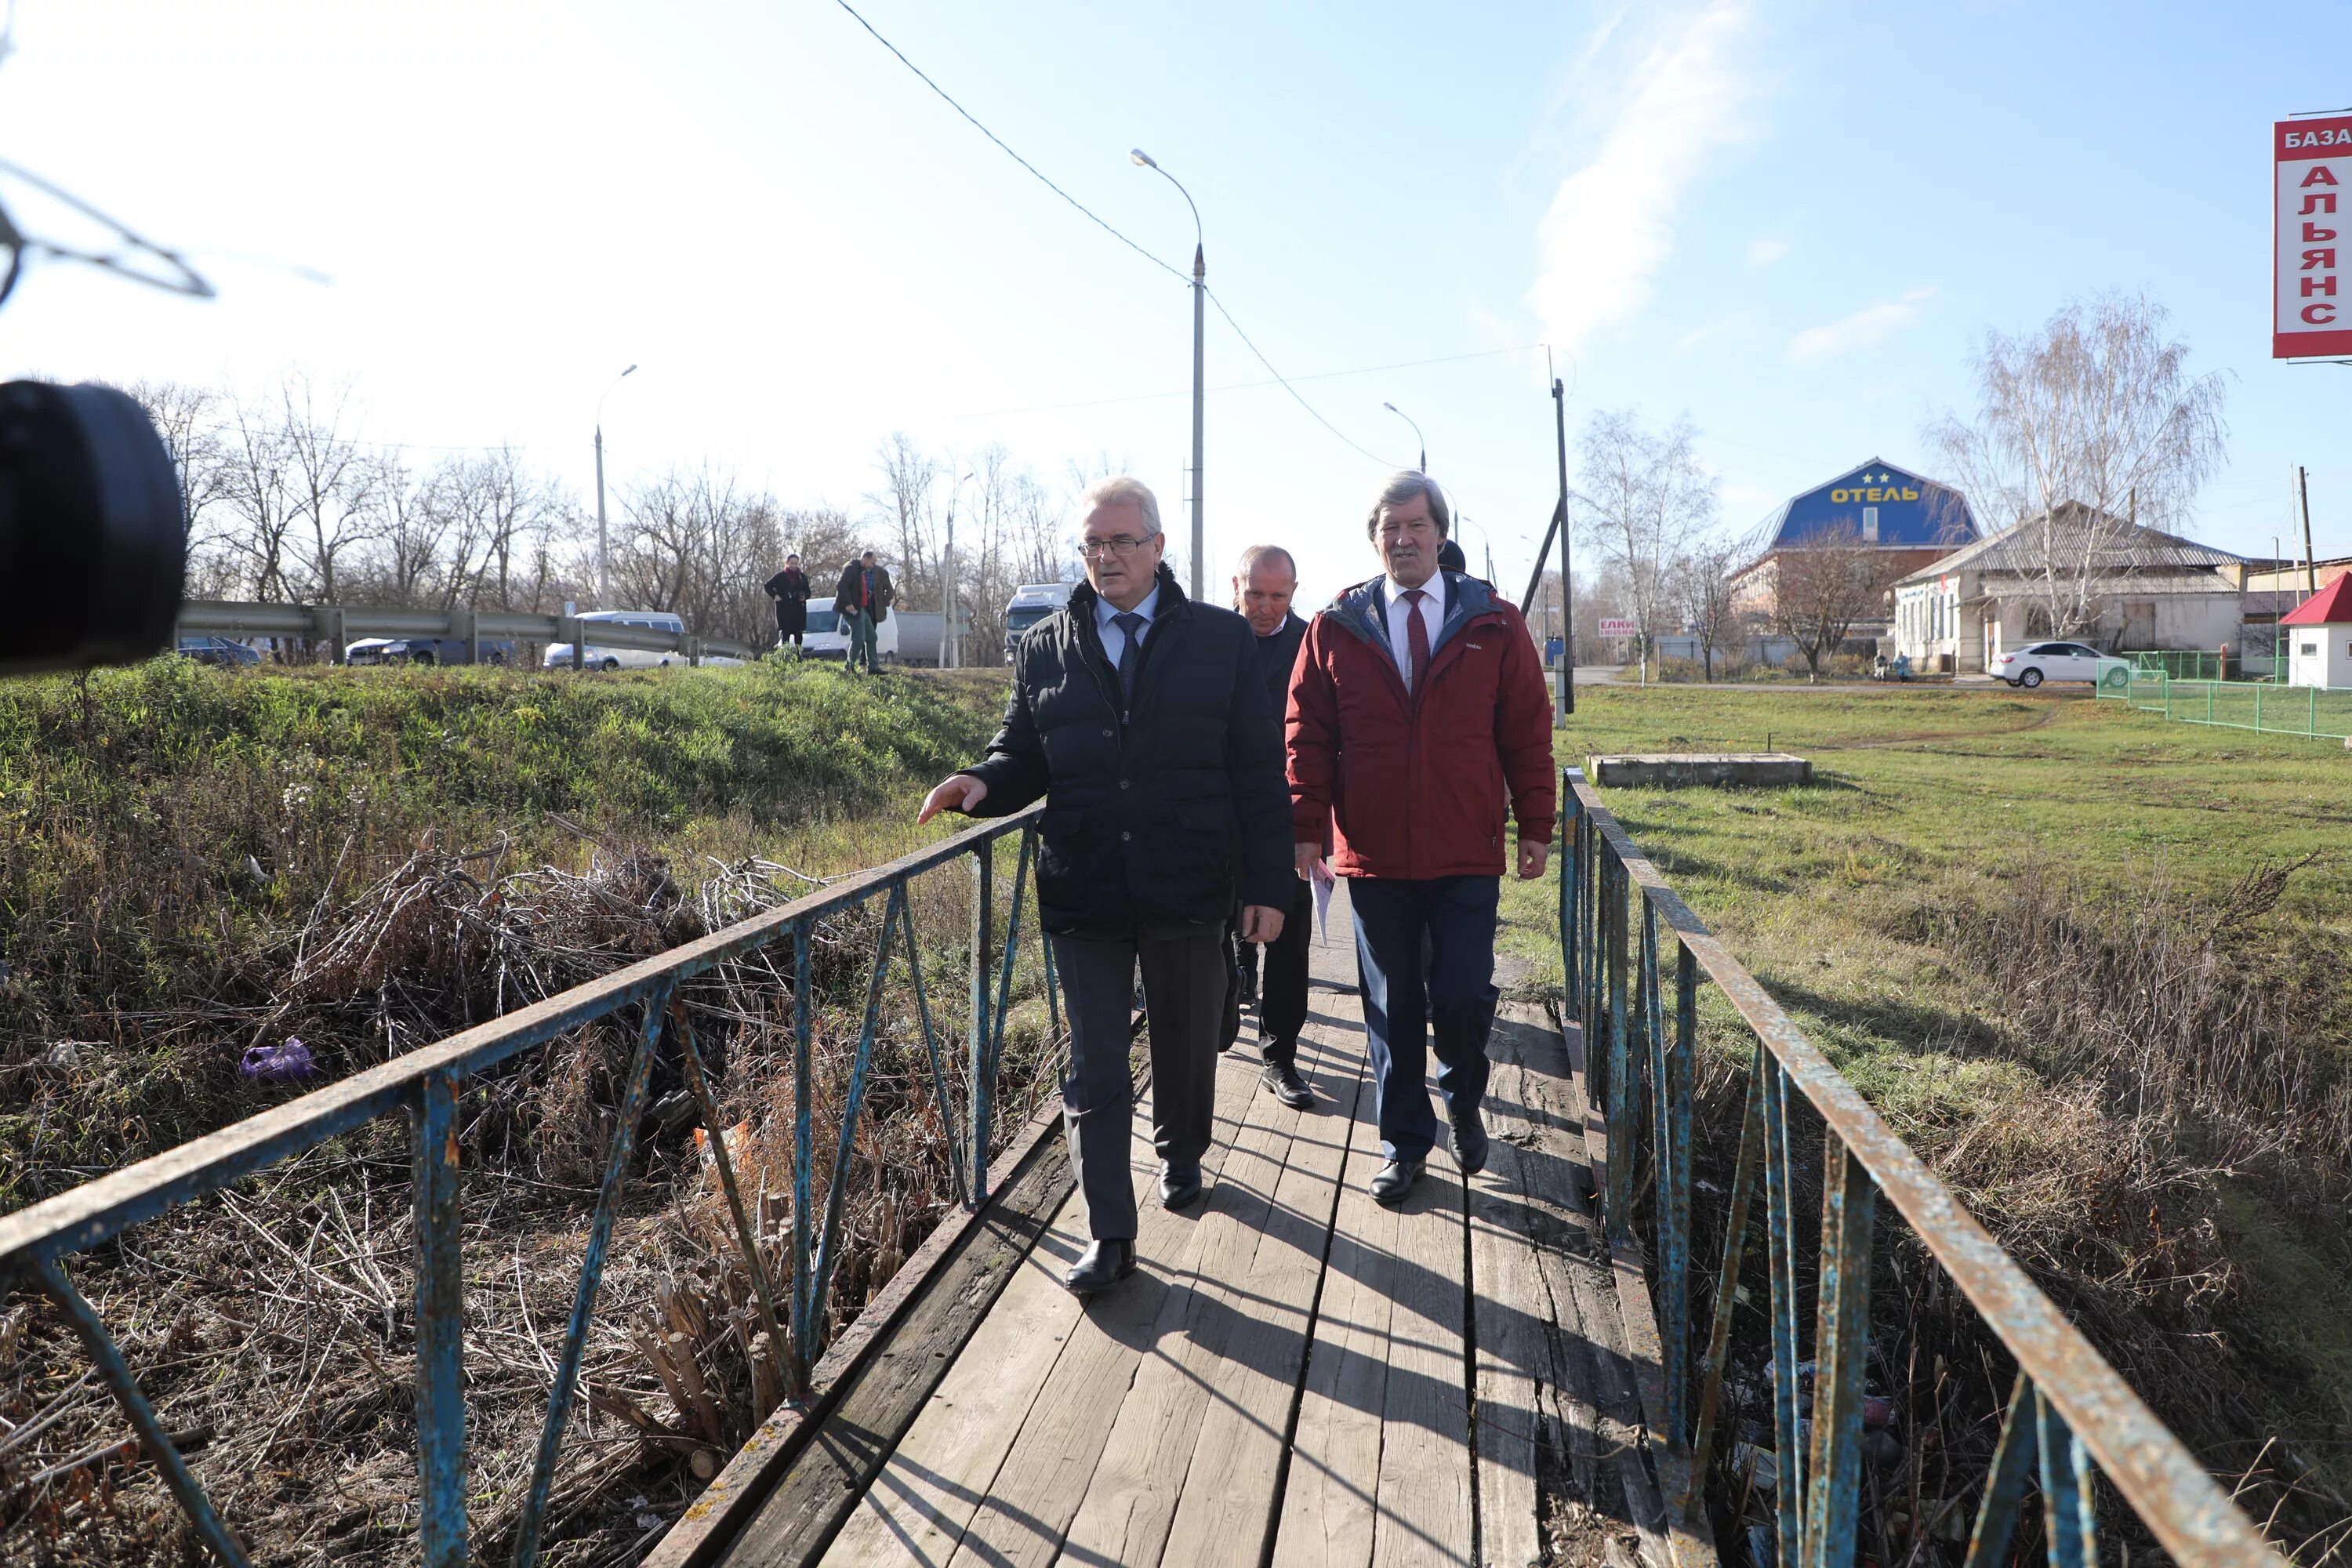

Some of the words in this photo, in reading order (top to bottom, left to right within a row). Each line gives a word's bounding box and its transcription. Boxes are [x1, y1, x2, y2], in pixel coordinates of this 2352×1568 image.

[2285, 129, 2352, 149] БАЗА
[2298, 165, 2339, 325] АЛЬЯНС
[1831, 487, 1918, 503] ОТЕЛЬ
